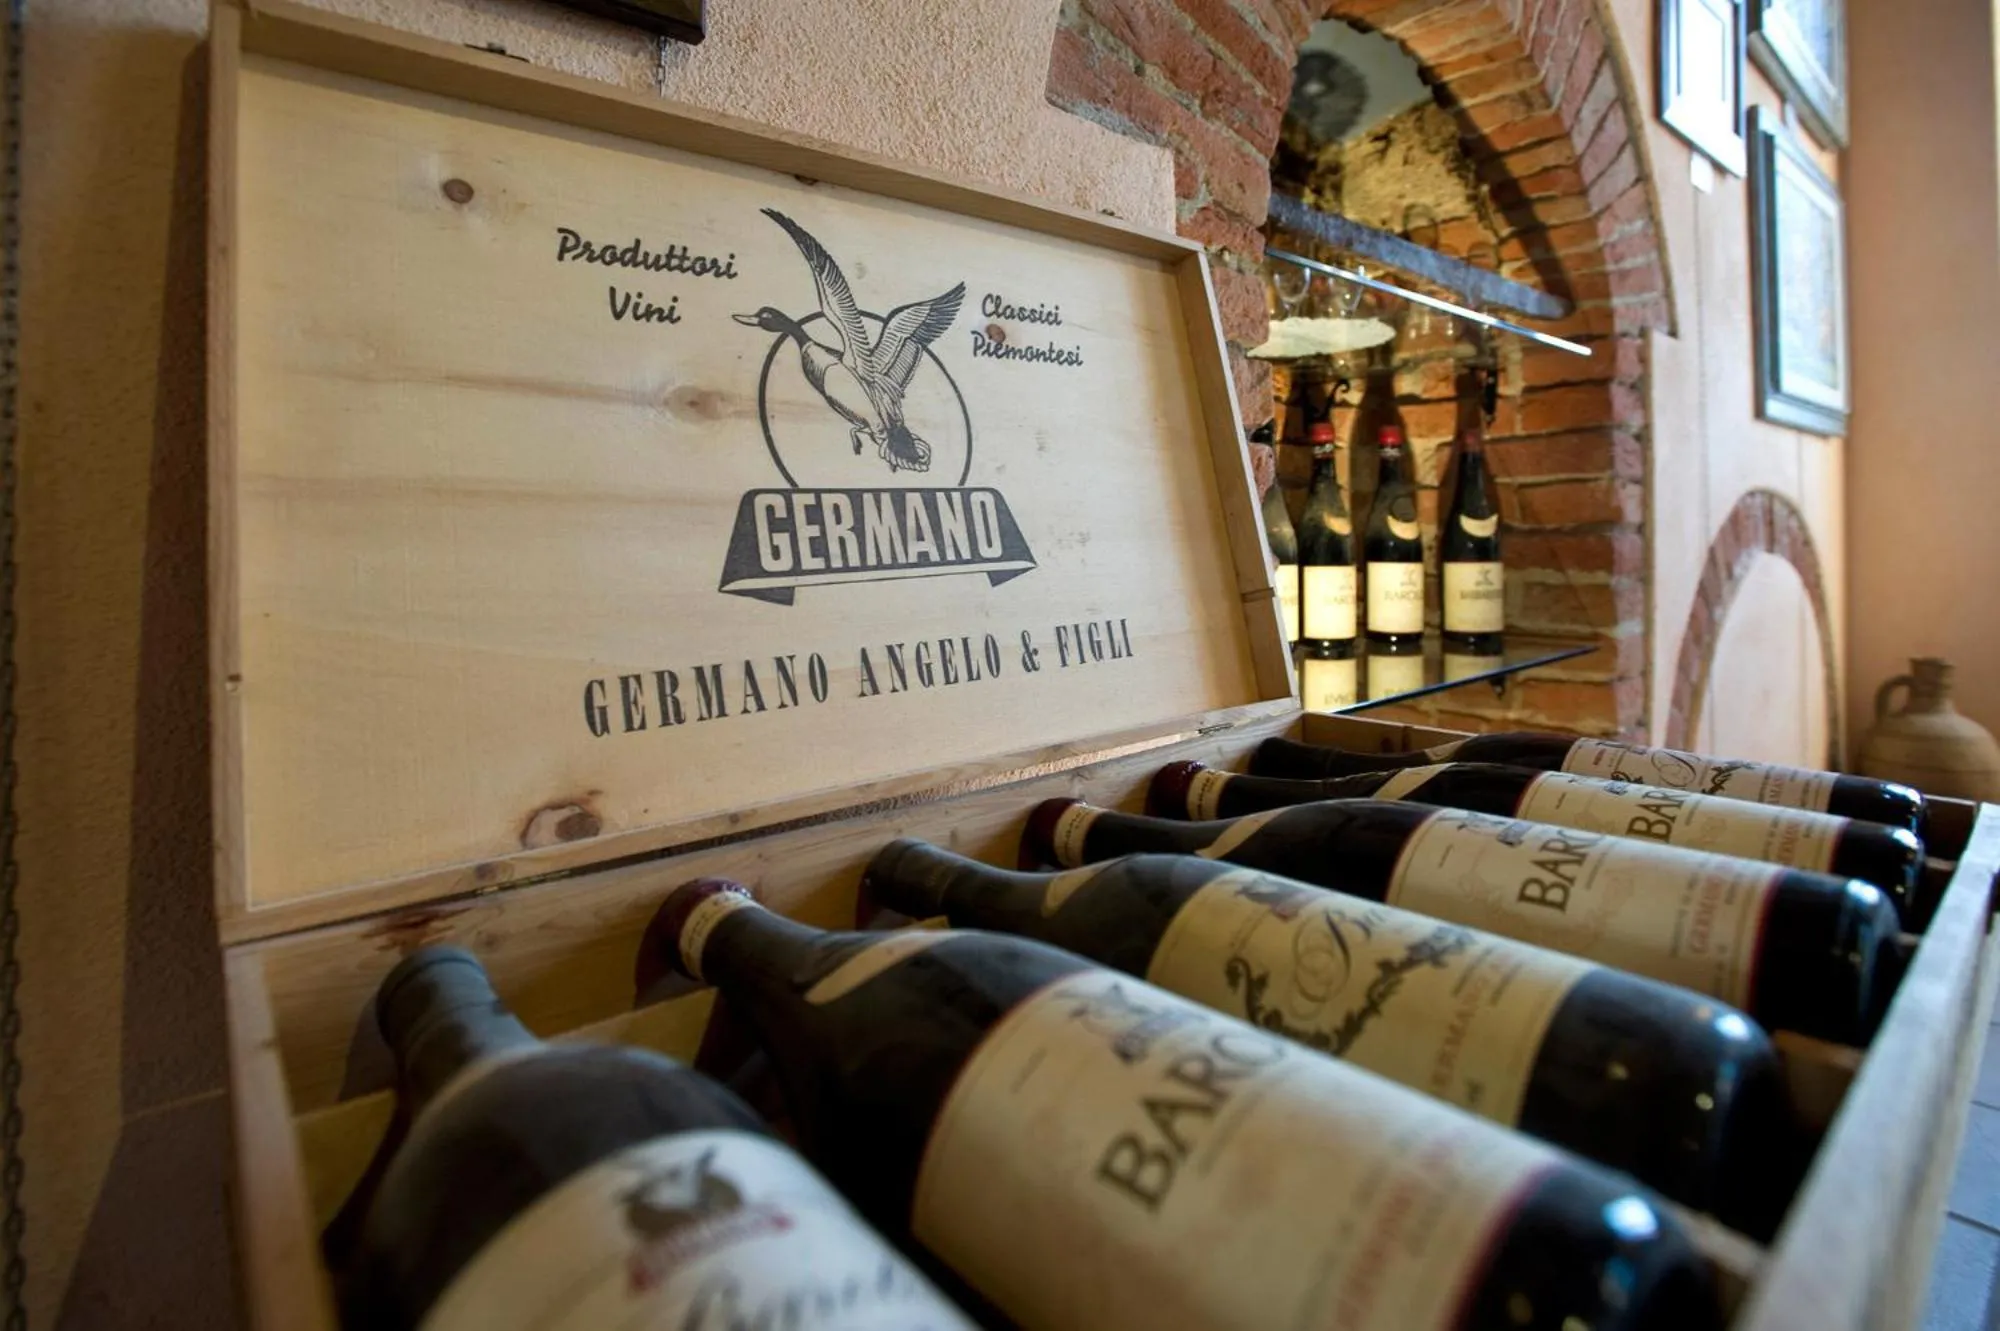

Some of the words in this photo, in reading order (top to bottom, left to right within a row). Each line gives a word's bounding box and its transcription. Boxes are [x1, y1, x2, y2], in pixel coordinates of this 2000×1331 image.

[557, 228, 739, 280] Produttori
[608, 285, 682, 325] Vini
[981, 293, 1063, 328] Classici
[971, 330, 1084, 367] Piemontesi
[754, 491, 1003, 572] GERMANO
[584, 654, 829, 738] GERMANO
[858, 633, 1001, 698] ANGELO
[1020, 629, 1041, 673] &
[1055, 618, 1134, 668] FIGLI
